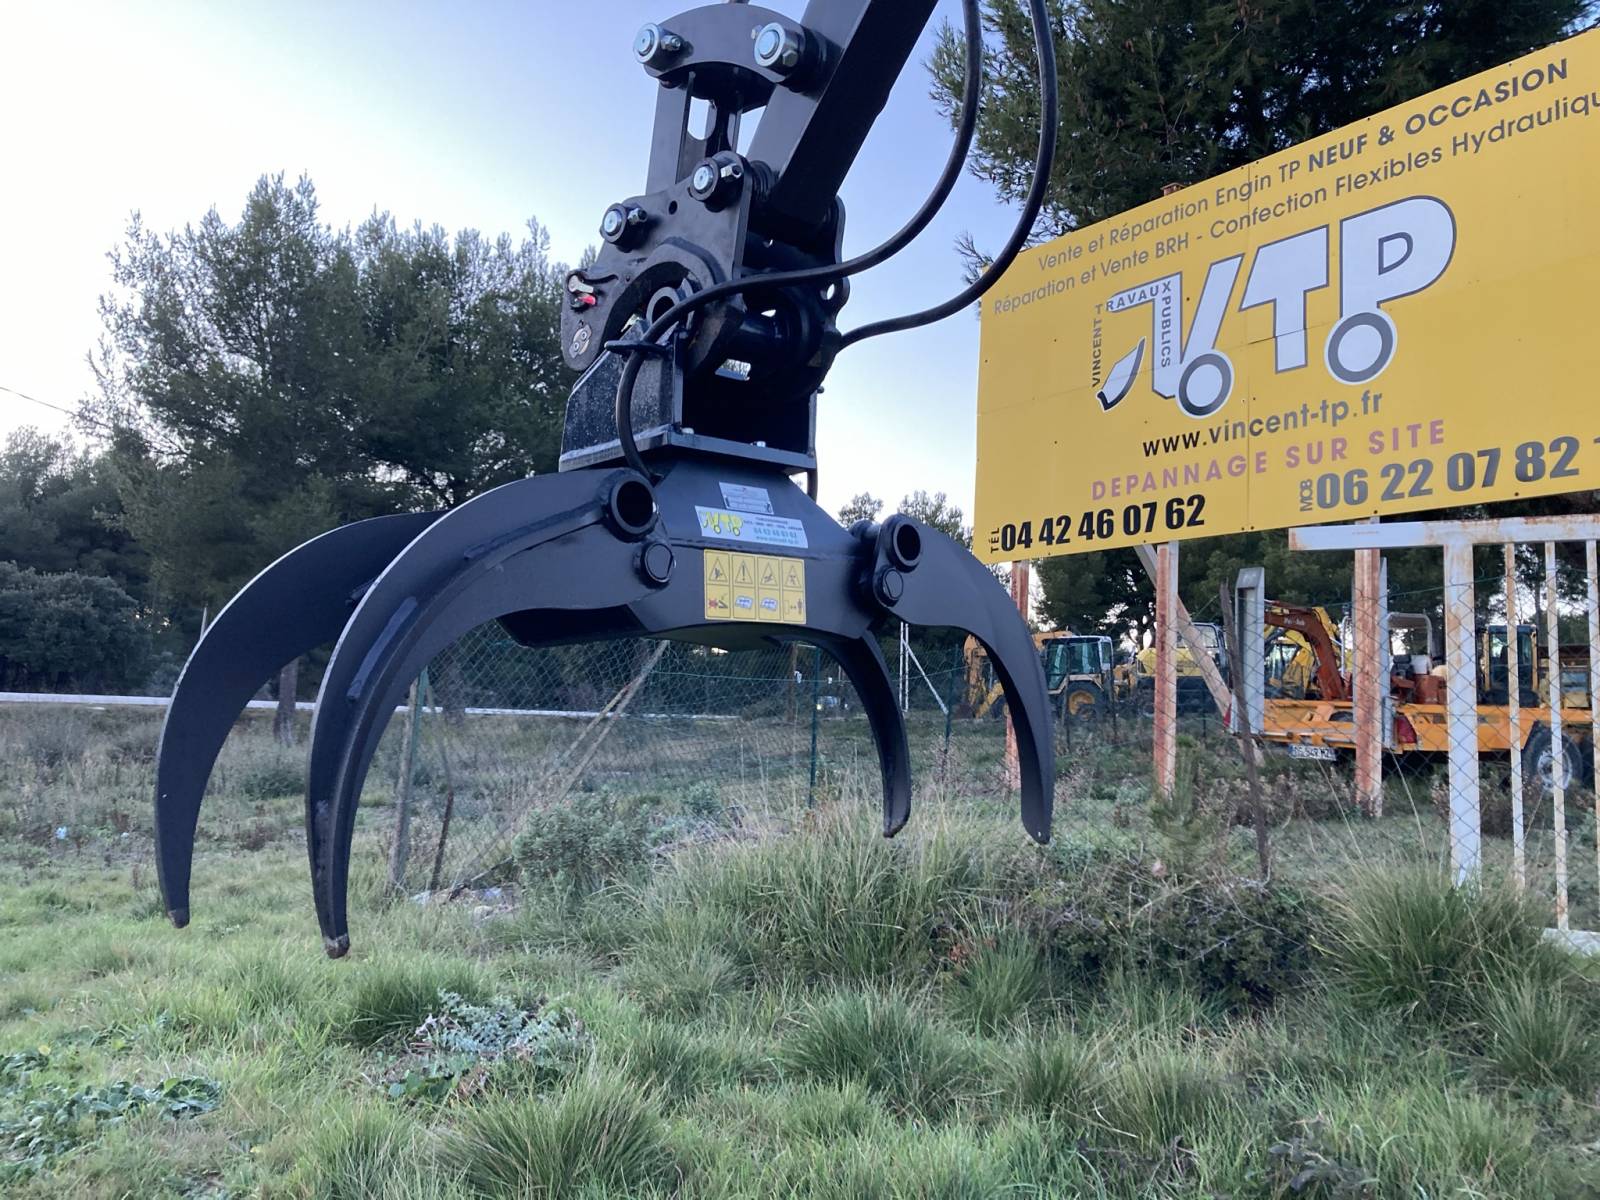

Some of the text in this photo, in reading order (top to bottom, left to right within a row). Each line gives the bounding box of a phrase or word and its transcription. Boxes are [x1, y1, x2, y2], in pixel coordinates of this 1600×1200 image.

[1038, 57, 1568, 272] Vente et Réparation Engin TP NEUF & OCCASION
[994, 274, 1075, 315] Réparation
[1080, 265, 1097, 285] et
[1100, 252, 1149, 279] Vente
[1155, 231, 1190, 258] BRH
[1210, 186, 1327, 240] Confection
[1336, 145, 1442, 197] Flexibles
[1091, 280, 1172, 389] VINCENT TRAVAUX PUBLICS
[1091, 419, 1445, 501] DEPANNAGE SUR SITE
[1142, 390, 1384, 458] www.vincent-tp.fr
[1299, 436, 1580, 513] MOB 06 22 07 82
[990, 493, 1206, 554] TÉL 04 42 46 07 62
